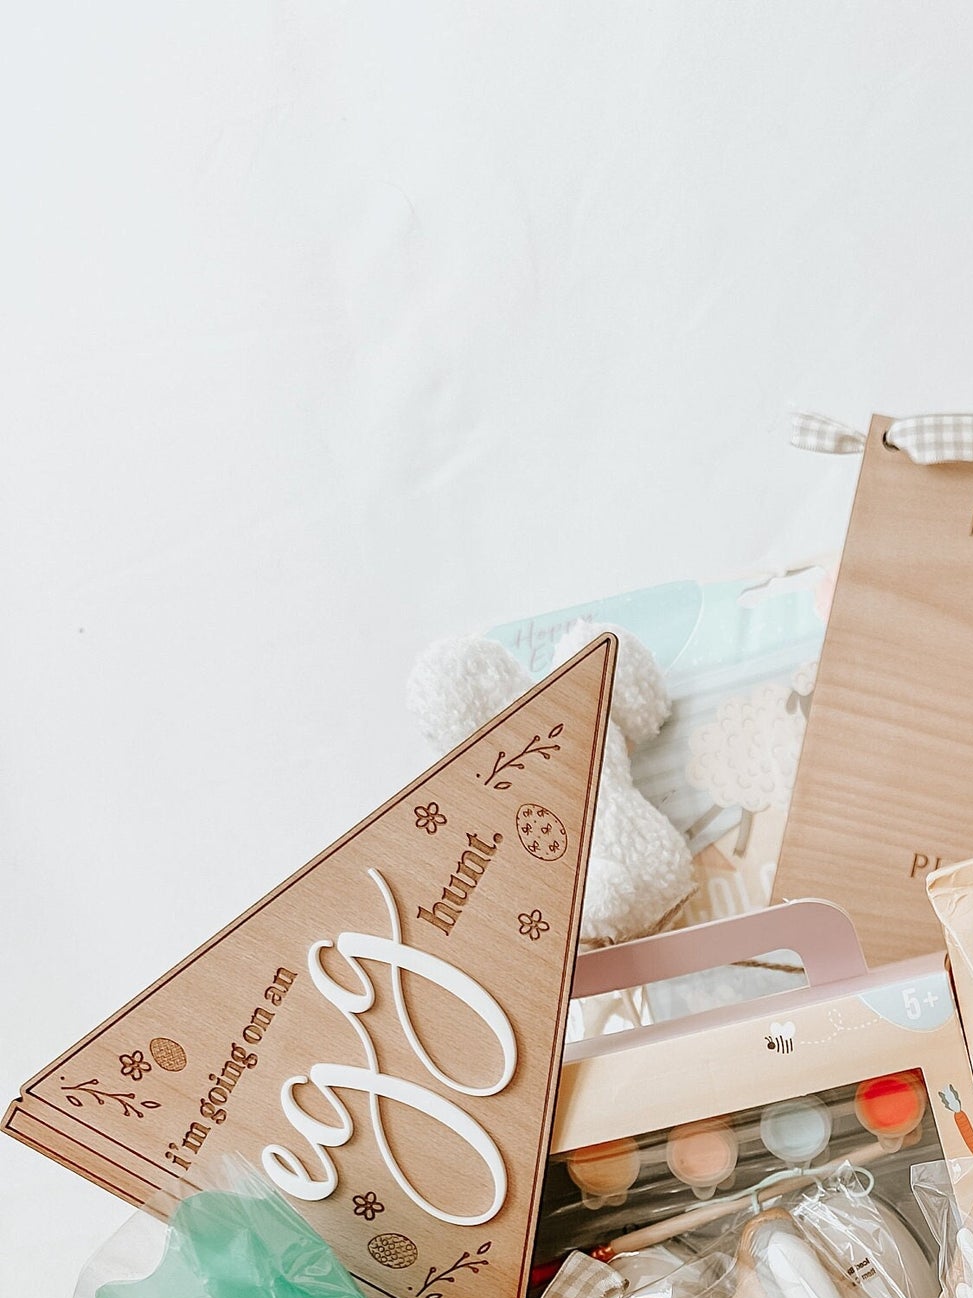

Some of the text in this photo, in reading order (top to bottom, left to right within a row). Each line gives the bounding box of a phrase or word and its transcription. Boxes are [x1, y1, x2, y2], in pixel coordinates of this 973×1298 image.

[416, 832, 503, 936] hunt.
[165, 967, 298, 1171] i'm going on an
[261, 867, 518, 1227] egg
[902, 988, 939, 1019] 5+
